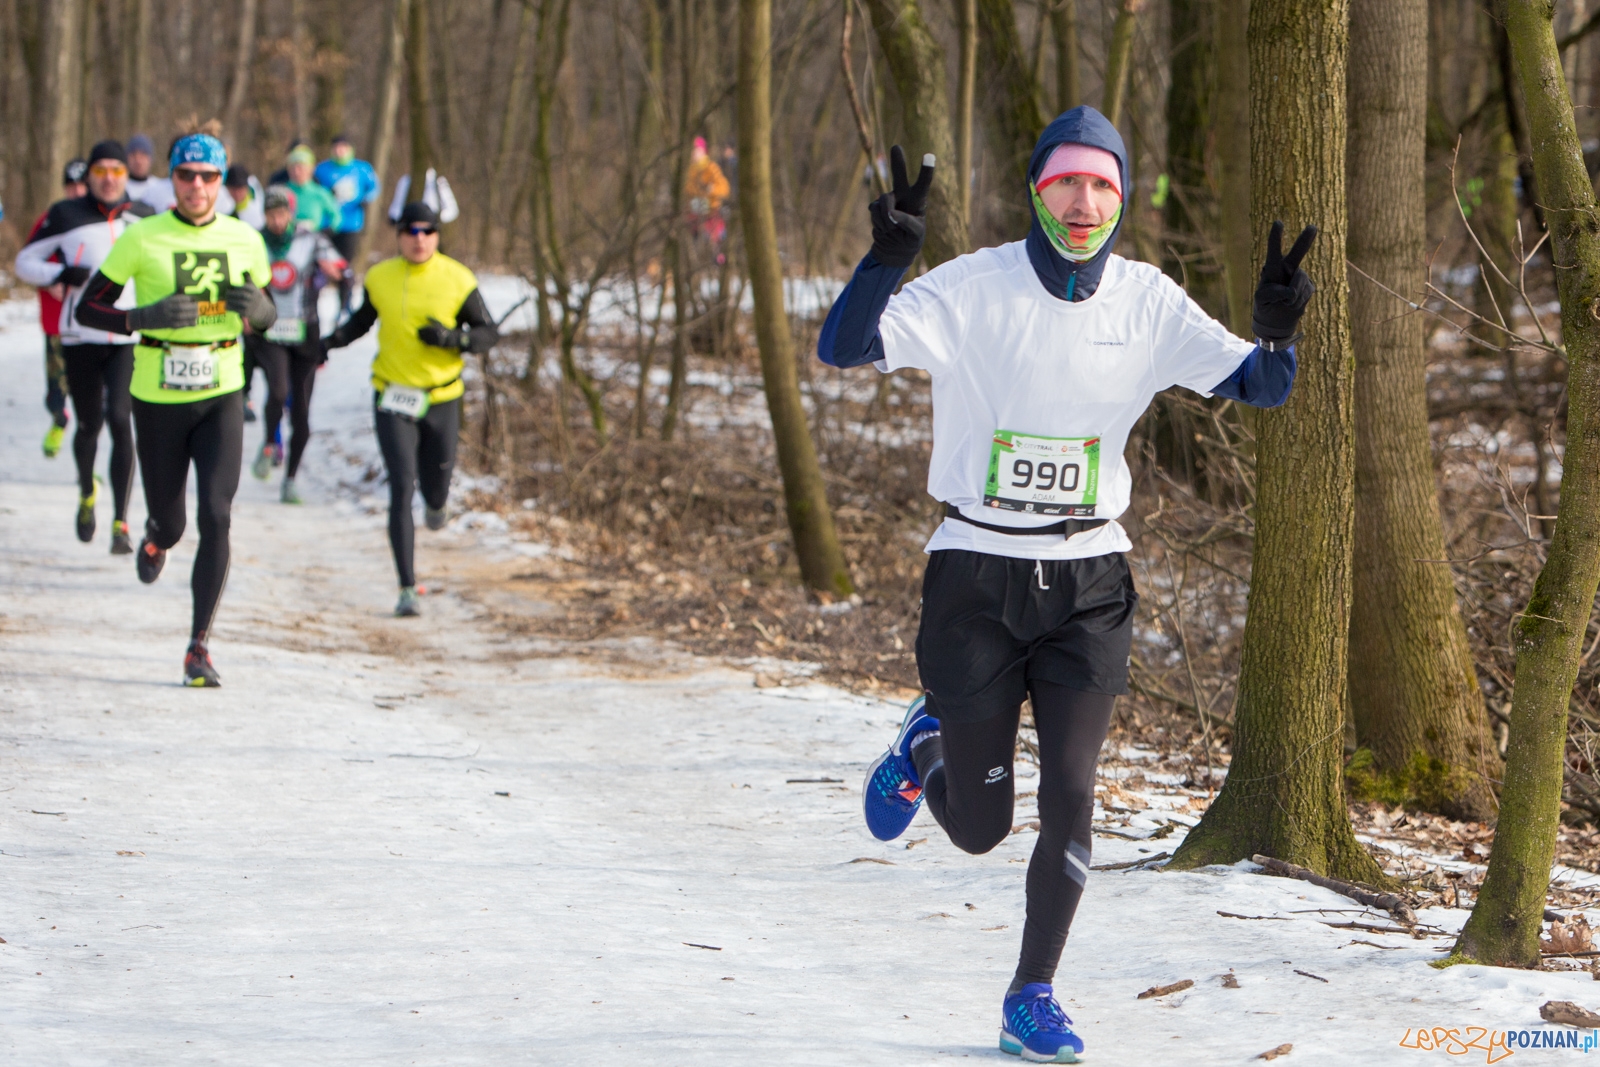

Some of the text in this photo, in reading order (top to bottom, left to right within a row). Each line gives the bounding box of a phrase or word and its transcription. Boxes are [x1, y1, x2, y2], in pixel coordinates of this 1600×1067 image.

[168, 359, 212, 377] 1266
[1011, 459, 1080, 492] 990
[1031, 493, 1056, 502] ADAM
